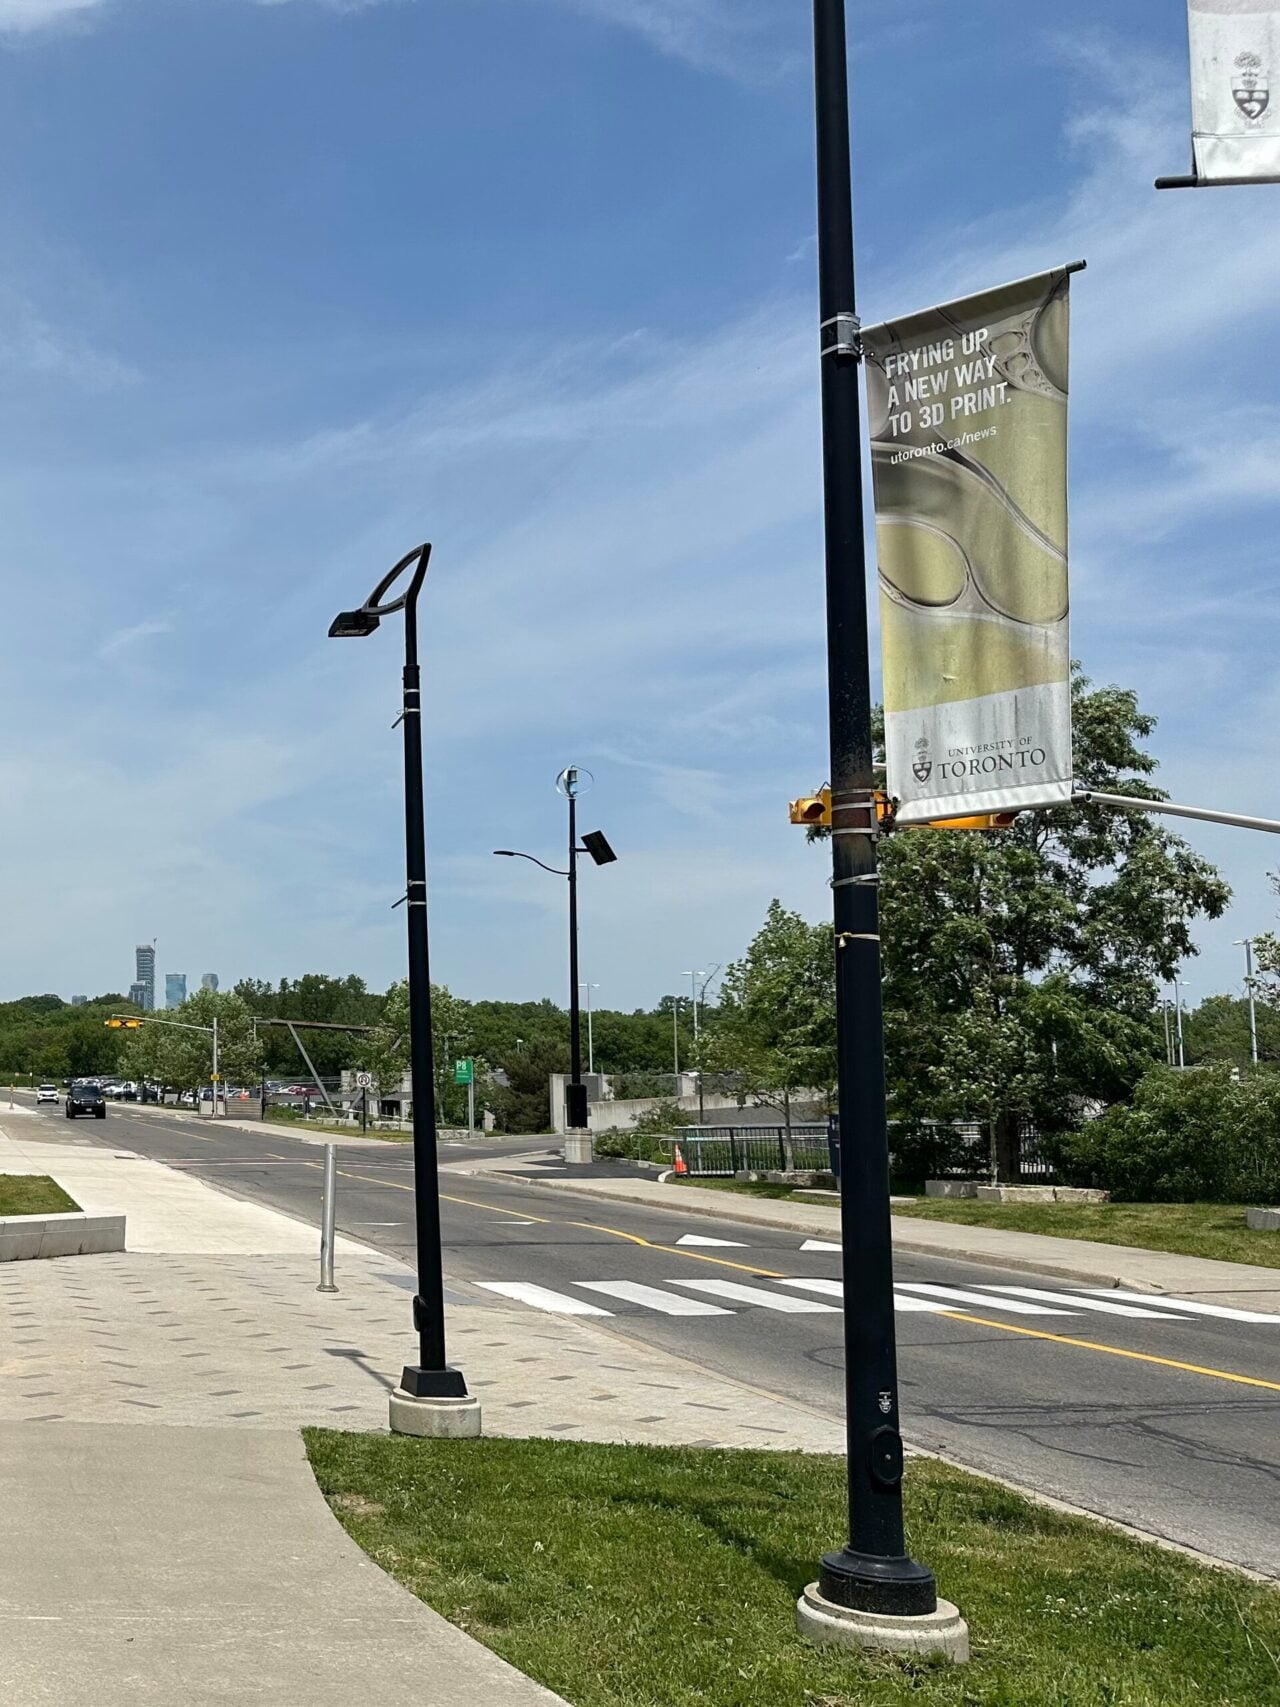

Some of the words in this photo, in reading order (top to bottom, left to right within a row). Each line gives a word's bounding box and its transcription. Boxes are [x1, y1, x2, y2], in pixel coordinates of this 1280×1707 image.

[885, 338, 954, 379] FRYING
[961, 328, 989, 356] UP
[887, 385, 900, 409] A
[905, 370, 949, 403] NEW
[954, 355, 997, 387] WAY
[888, 410, 912, 437] TO
[919, 403, 944, 429] 3D
[950, 381, 1012, 420] PRINT.
[890, 425, 997, 465] utoronto.ca/news
[937, 748, 1046, 779] TORONTO
[948, 740, 1013, 758] UNIVERSITY
[1019, 736, 1033, 746] OF
[456, 1060, 466, 1070] P8
